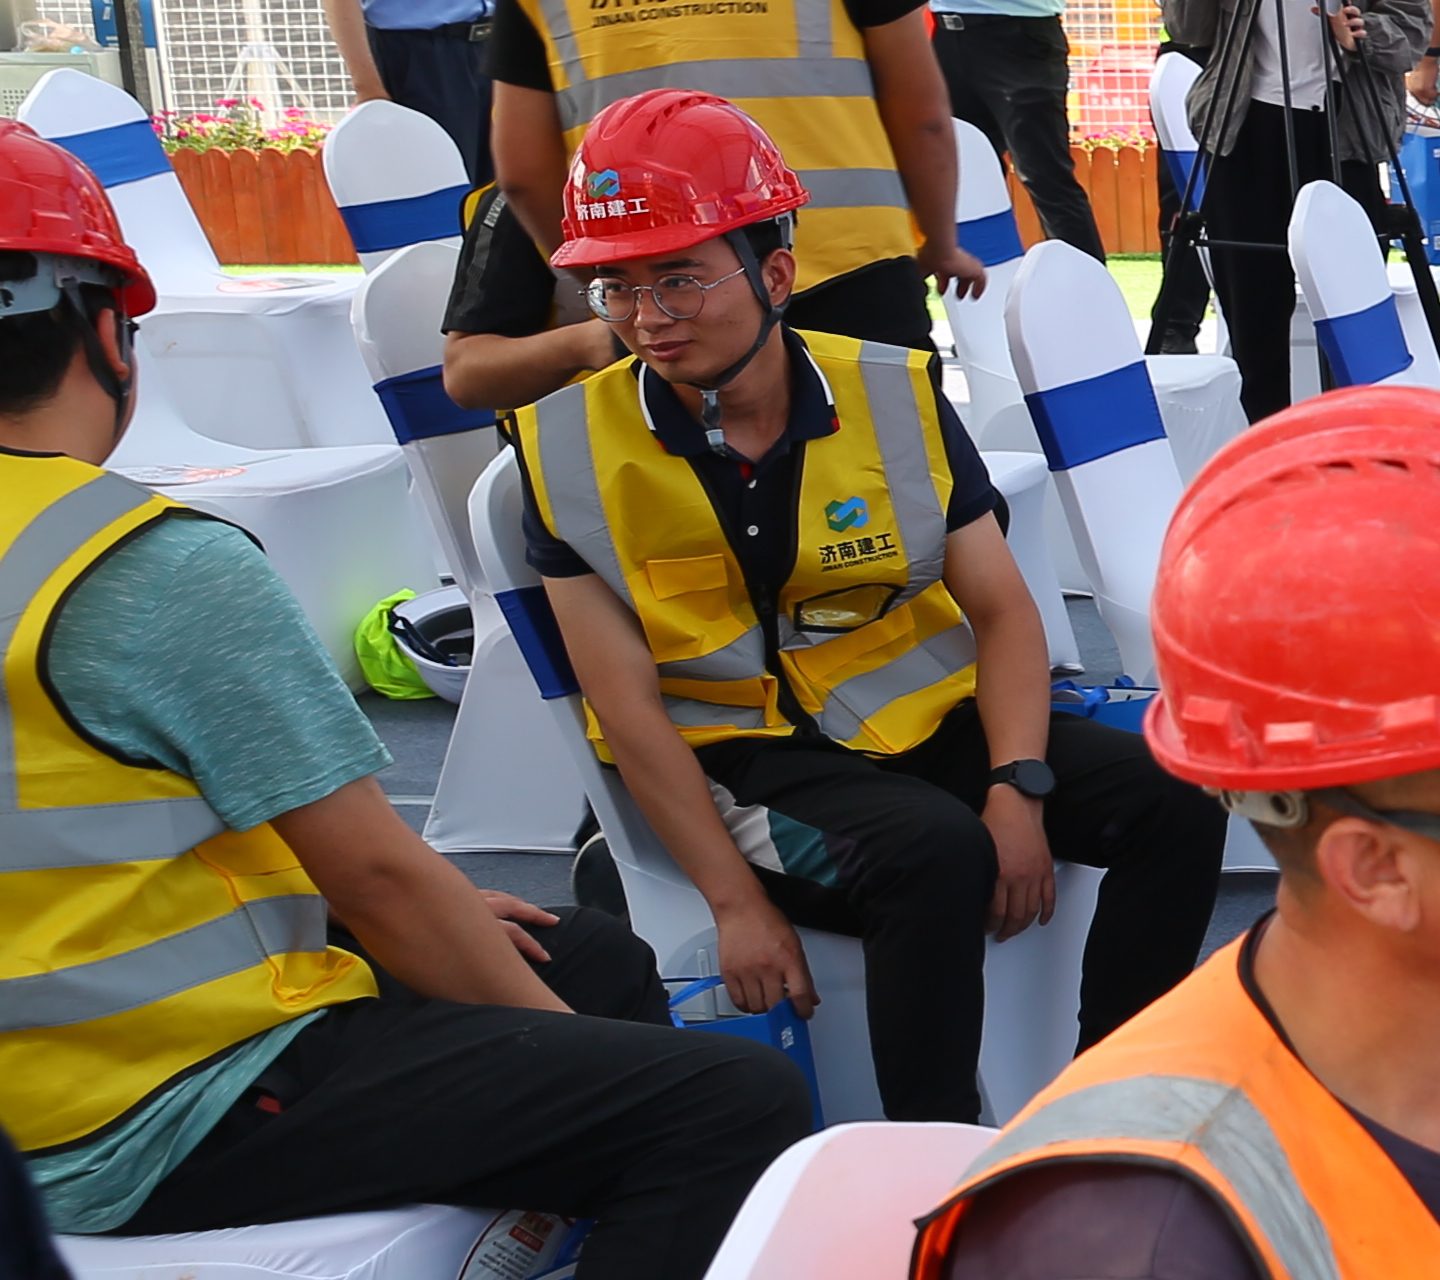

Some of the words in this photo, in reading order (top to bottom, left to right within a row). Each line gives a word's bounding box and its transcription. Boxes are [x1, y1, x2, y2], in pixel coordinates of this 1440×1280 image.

[592, 10, 636, 29] JINAN
[637, 1, 768, 21] CONSTRUCTION
[818, 532, 897, 564] 济南建工
